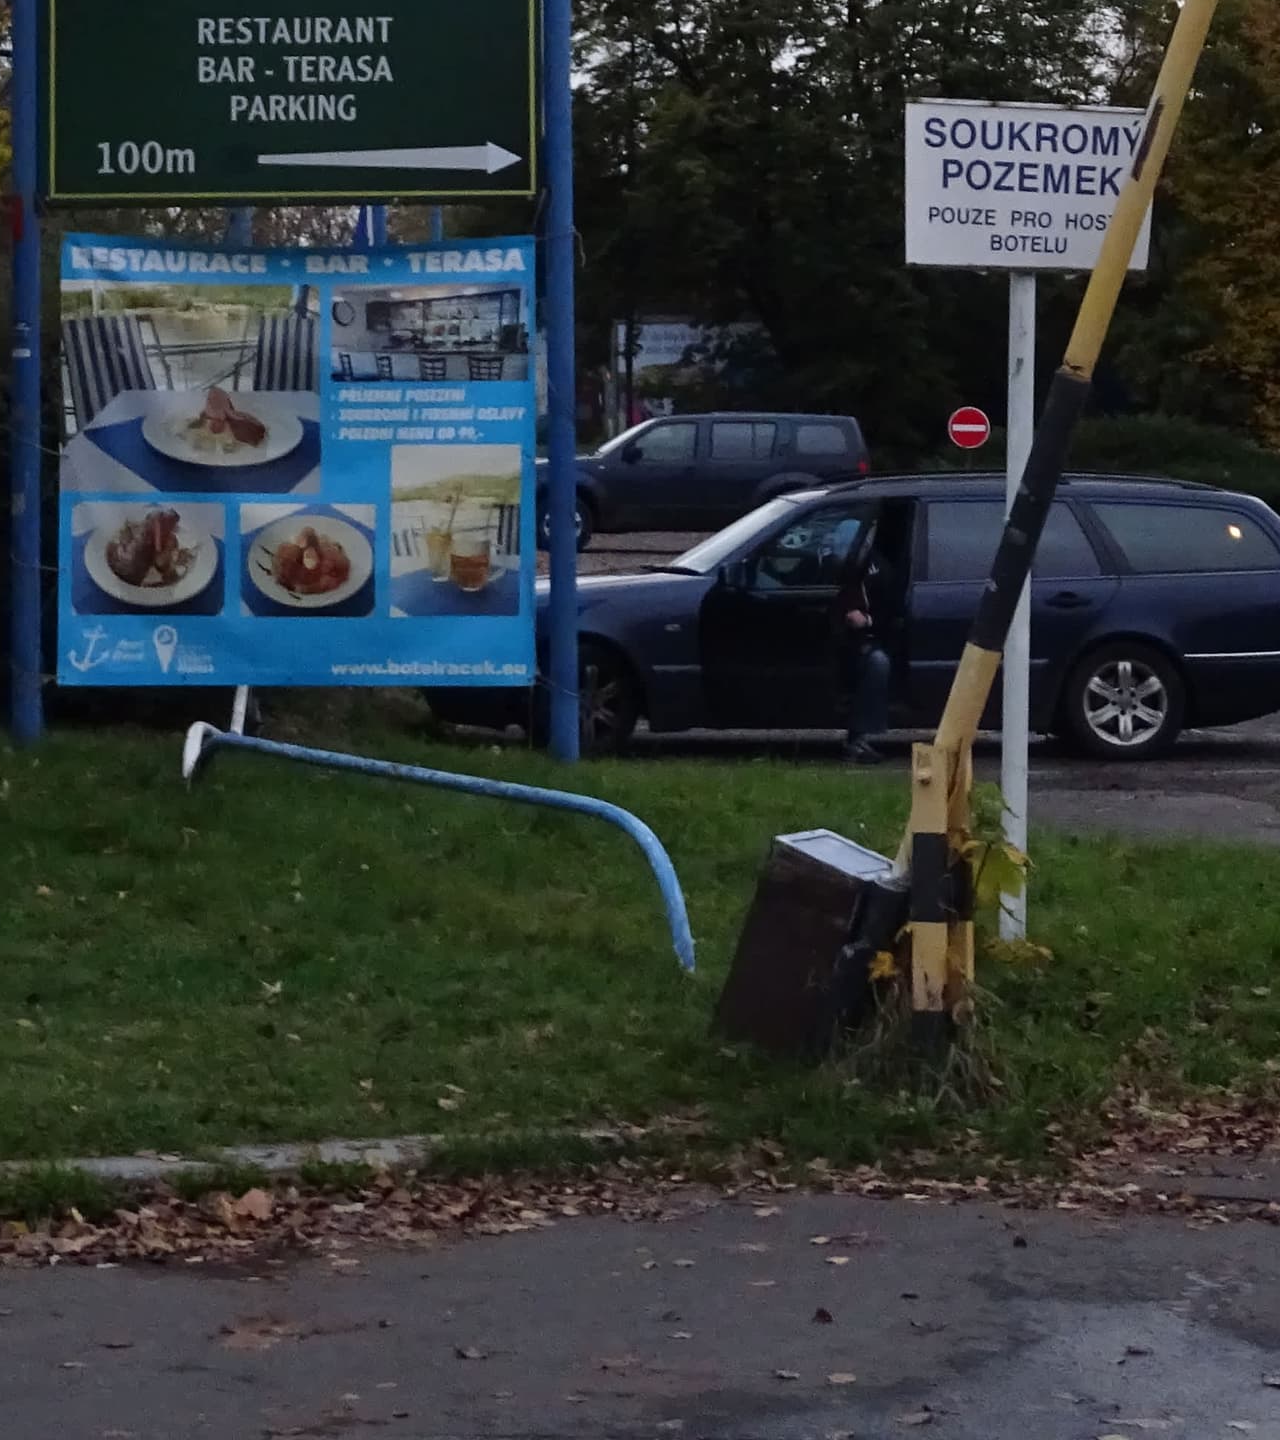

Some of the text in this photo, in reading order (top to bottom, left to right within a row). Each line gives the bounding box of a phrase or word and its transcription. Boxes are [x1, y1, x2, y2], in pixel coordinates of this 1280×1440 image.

[197, 16, 394, 45] RESTAURANT
[198, 56, 256, 83] BAR
[283, 55, 394, 83] TERASA
[230, 94, 357, 122] PARKING
[923, 117, 1142, 157] SOUKROMÝ
[96, 141, 196, 174] 100m
[941, 158, 1124, 197] POZEMEK
[928, 207, 1113, 232] POUZE PRO HOS
[990, 234, 1068, 254] BOTELU
[71, 245, 527, 274] RESTAURACE BAR TERASA
